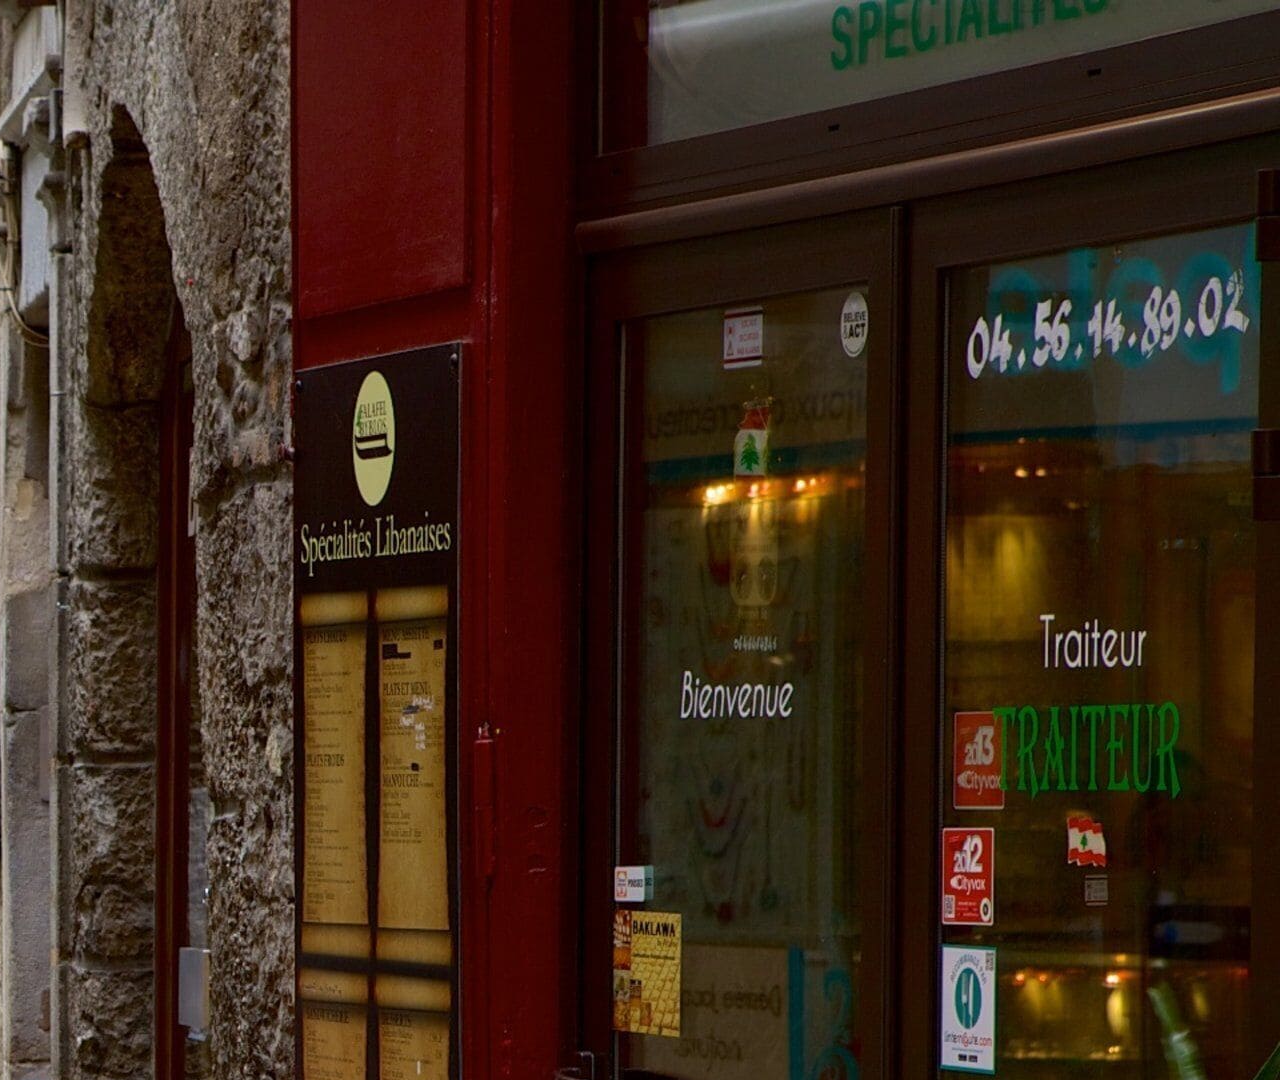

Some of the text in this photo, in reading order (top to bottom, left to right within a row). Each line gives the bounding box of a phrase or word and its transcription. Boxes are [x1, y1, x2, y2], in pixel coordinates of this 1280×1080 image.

[843, 311, 867, 324] BELIEVE
[848, 322, 866, 338] ACT
[966, 268, 1251, 379] 04.56.14.89.02
[360, 401, 386, 419] FALAFEL
[301, 510, 452, 577] Spécialités Libanaises
[1040, 614, 1147, 669] Traiteur
[680, 670, 794, 719] Bienvenue
[964, 726, 995, 767] 2013
[993, 702, 1182, 799] TRAITEUR
[962, 770, 1002, 795] Cityvox
[954, 834, 984, 873] 2012
[954, 874, 987, 896] Cityvox
[632, 920, 676, 938] BAKLAWA
